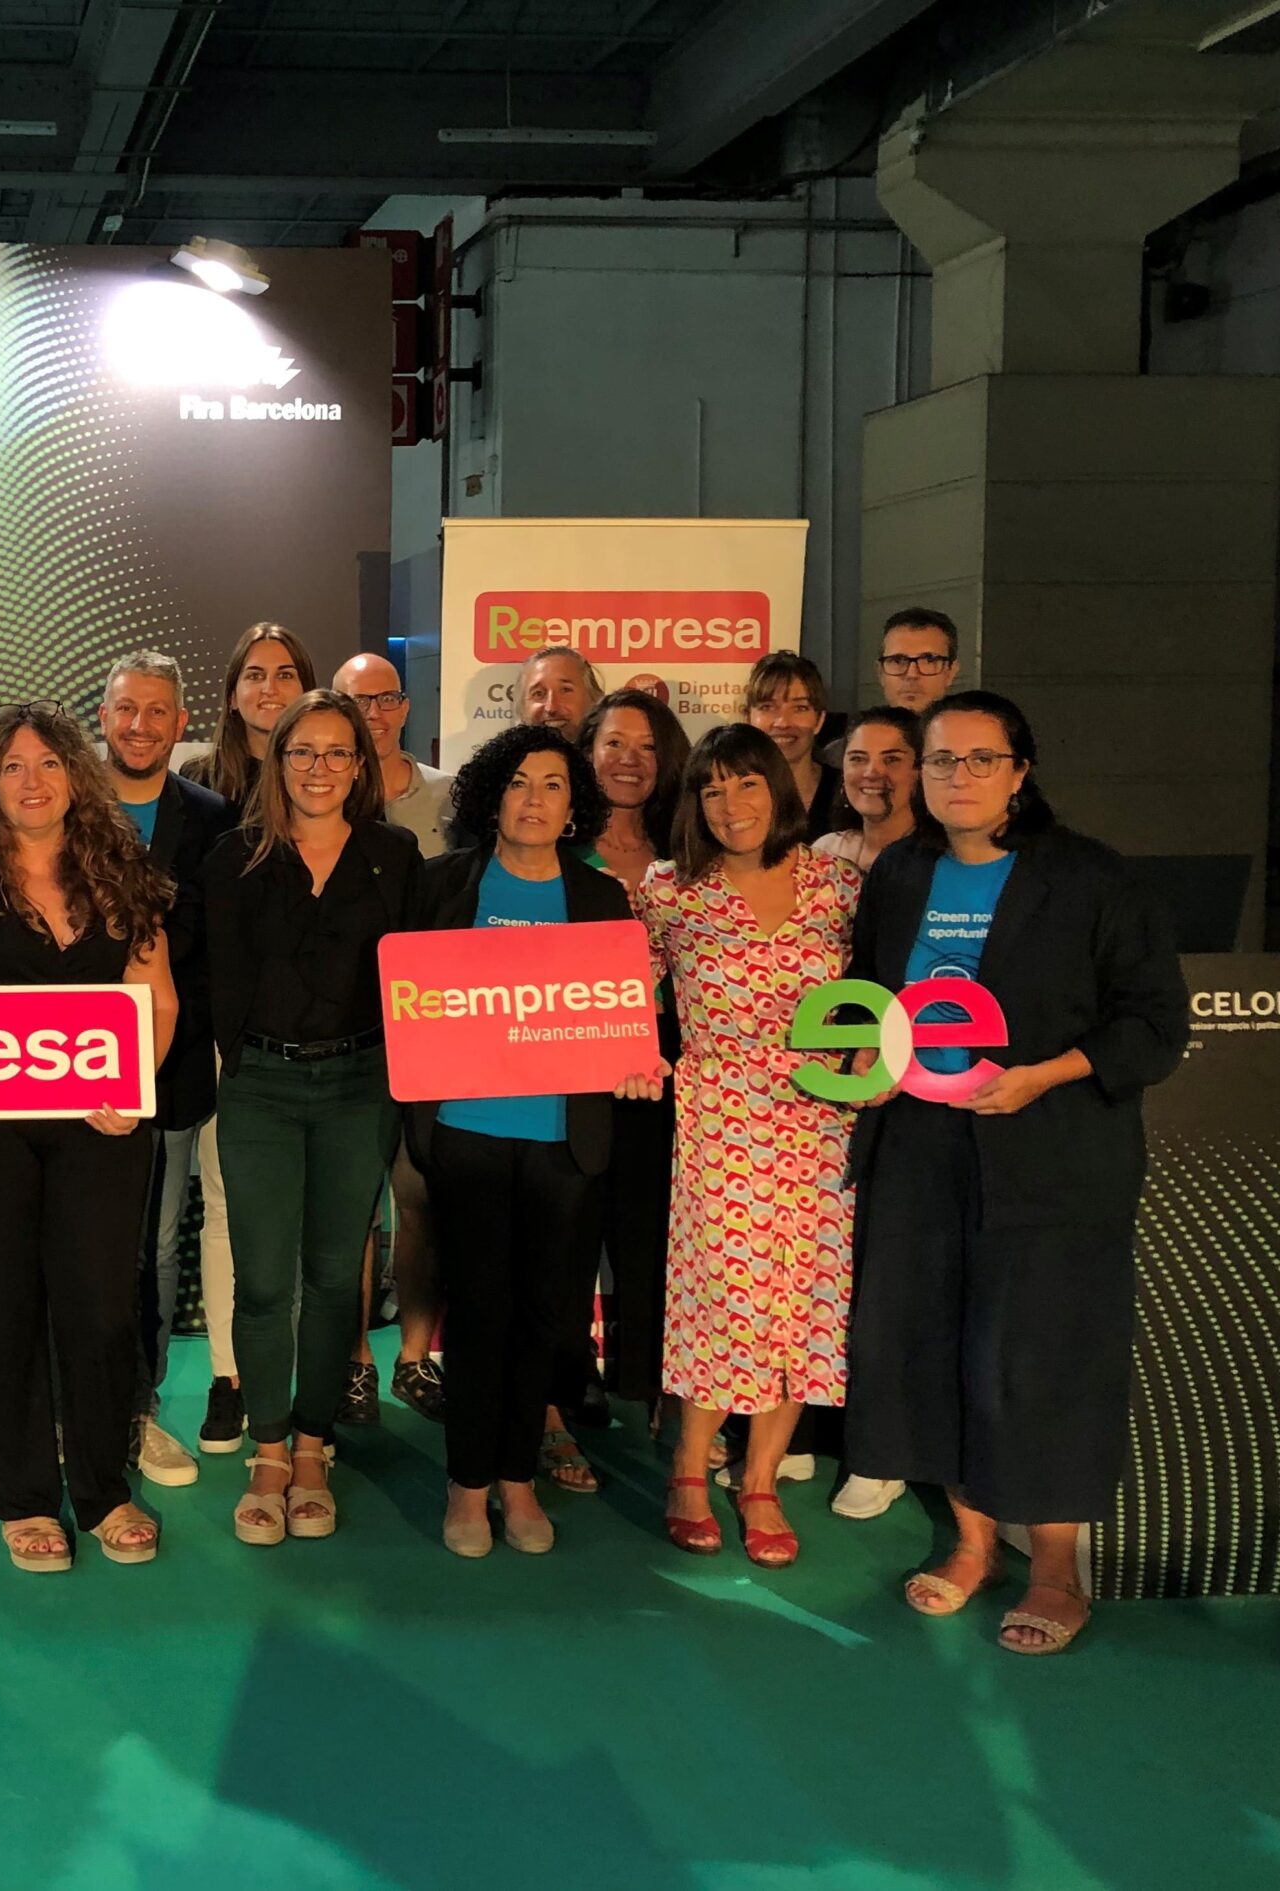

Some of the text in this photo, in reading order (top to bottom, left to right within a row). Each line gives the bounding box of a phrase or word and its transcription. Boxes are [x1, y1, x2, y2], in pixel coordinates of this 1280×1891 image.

[179, 394, 342, 421] Fira Barcelona
[488, 605, 762, 657] Reempresa
[487, 915, 531, 927] Creem
[390, 979, 647, 1022] Reempresa
[1190, 991, 1280, 1017] CELO
[507, 1021, 650, 1044] #AvancemJunts
